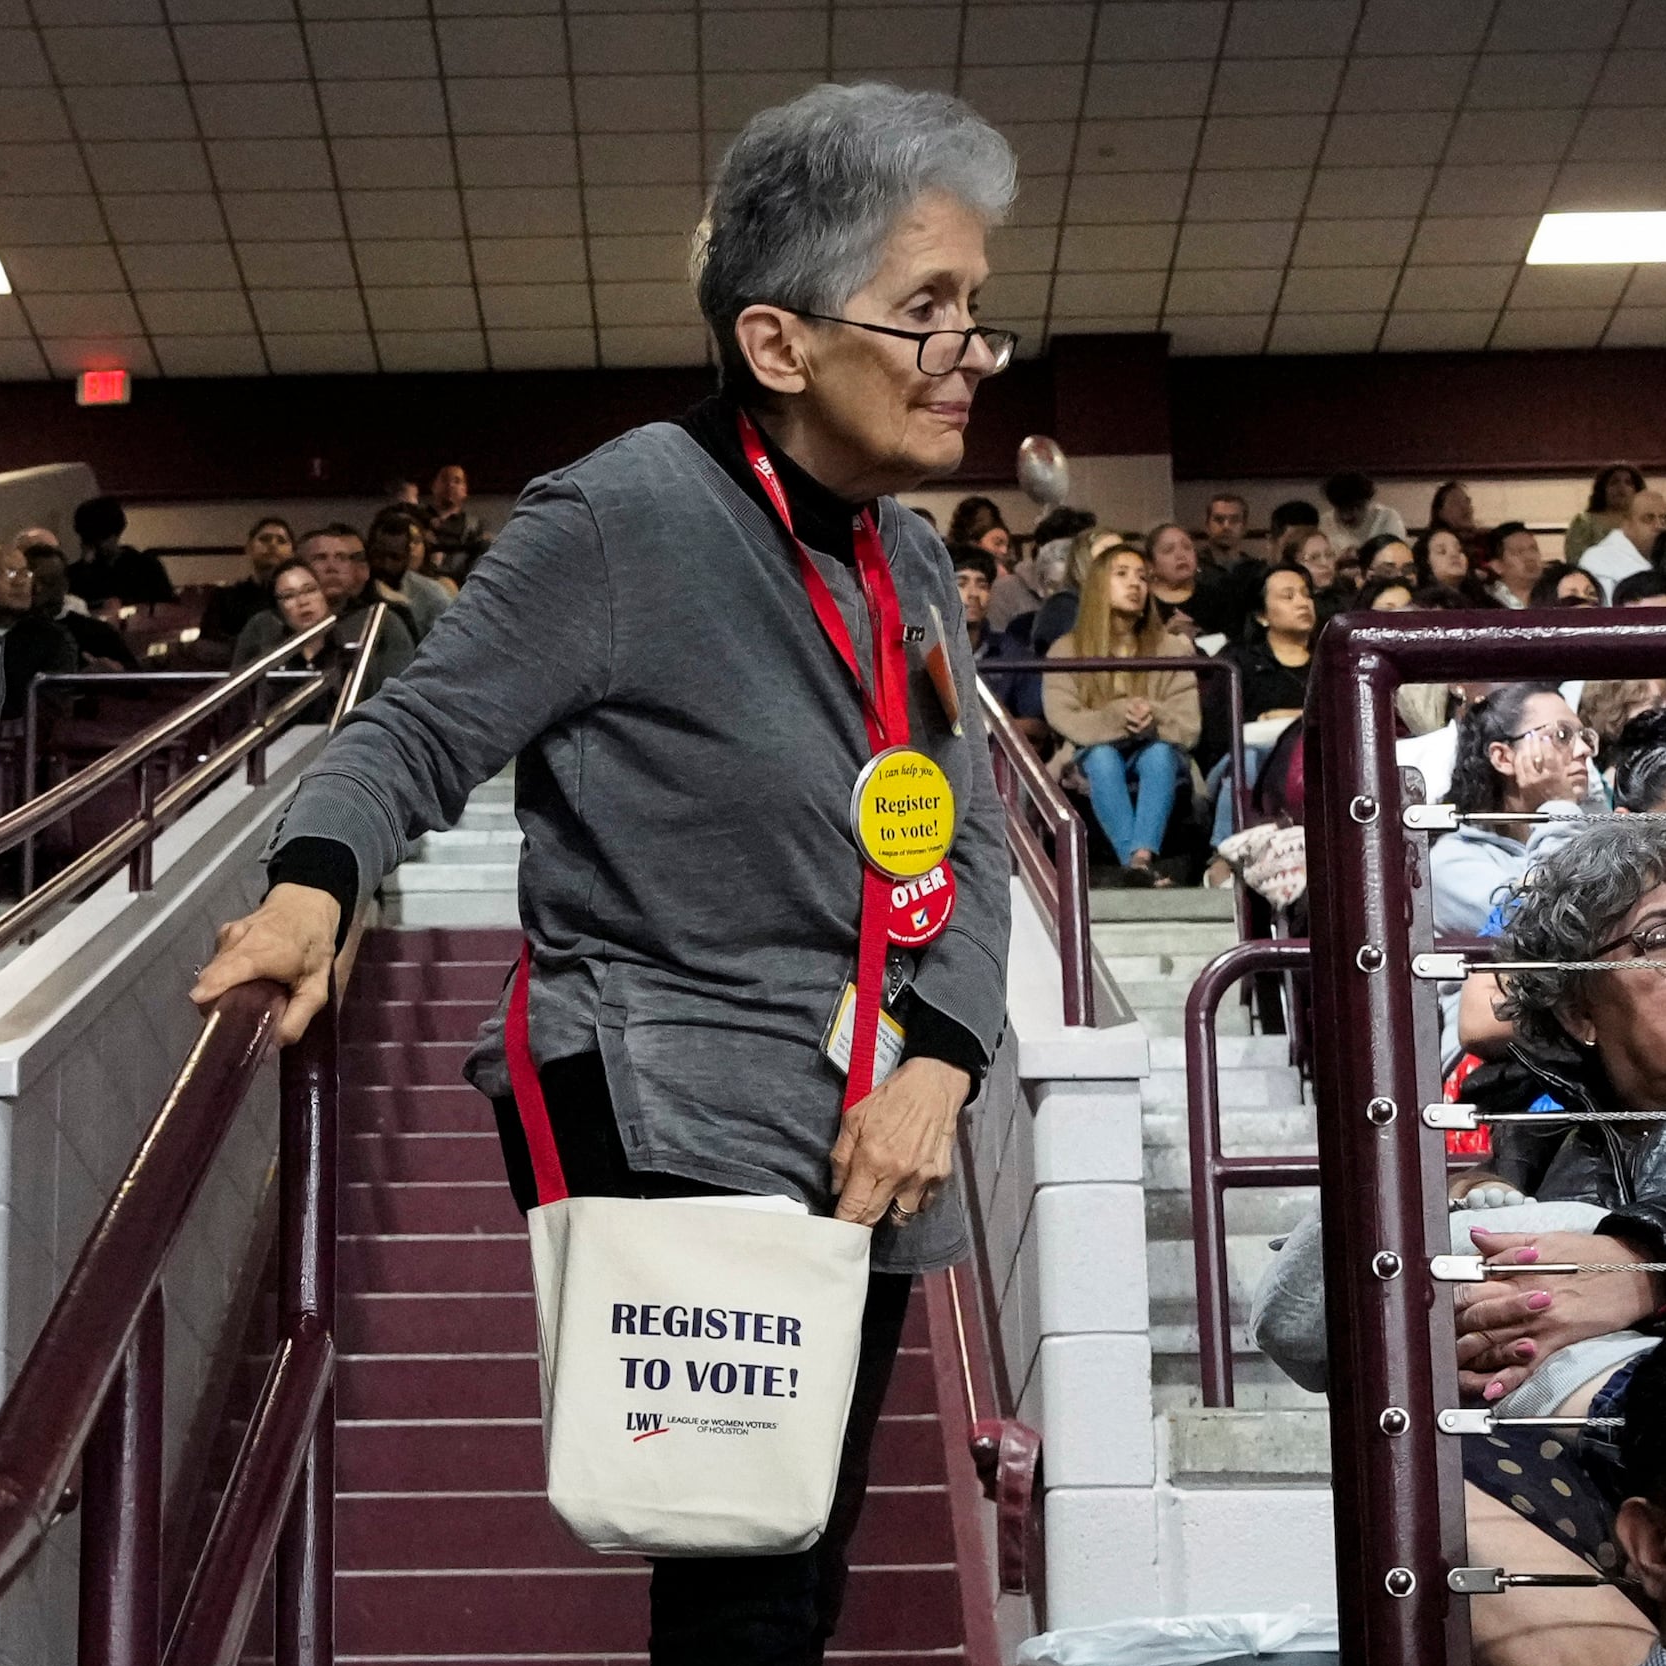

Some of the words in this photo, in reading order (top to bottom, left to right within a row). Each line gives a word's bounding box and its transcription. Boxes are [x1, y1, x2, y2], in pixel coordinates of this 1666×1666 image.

[884, 768, 899, 778] can
[901, 763, 918, 777] help
[918, 766, 934, 778] you
[875, 795, 940, 816] Register
[880, 826, 895, 841] to
[900, 819, 938, 839] vote!
[890, 866, 948, 909] OTER
[611, 1303, 801, 1346] REGISTER
[619, 1356, 671, 1391] TO
[685, 1360, 799, 1399] VOTE!
[626, 1412, 663, 1432] LWV
[667, 1415, 699, 1425] LEAGUE
[710, 1419, 745, 1428] WOMEN
[709, 1427, 749, 1436] HOUSTON
